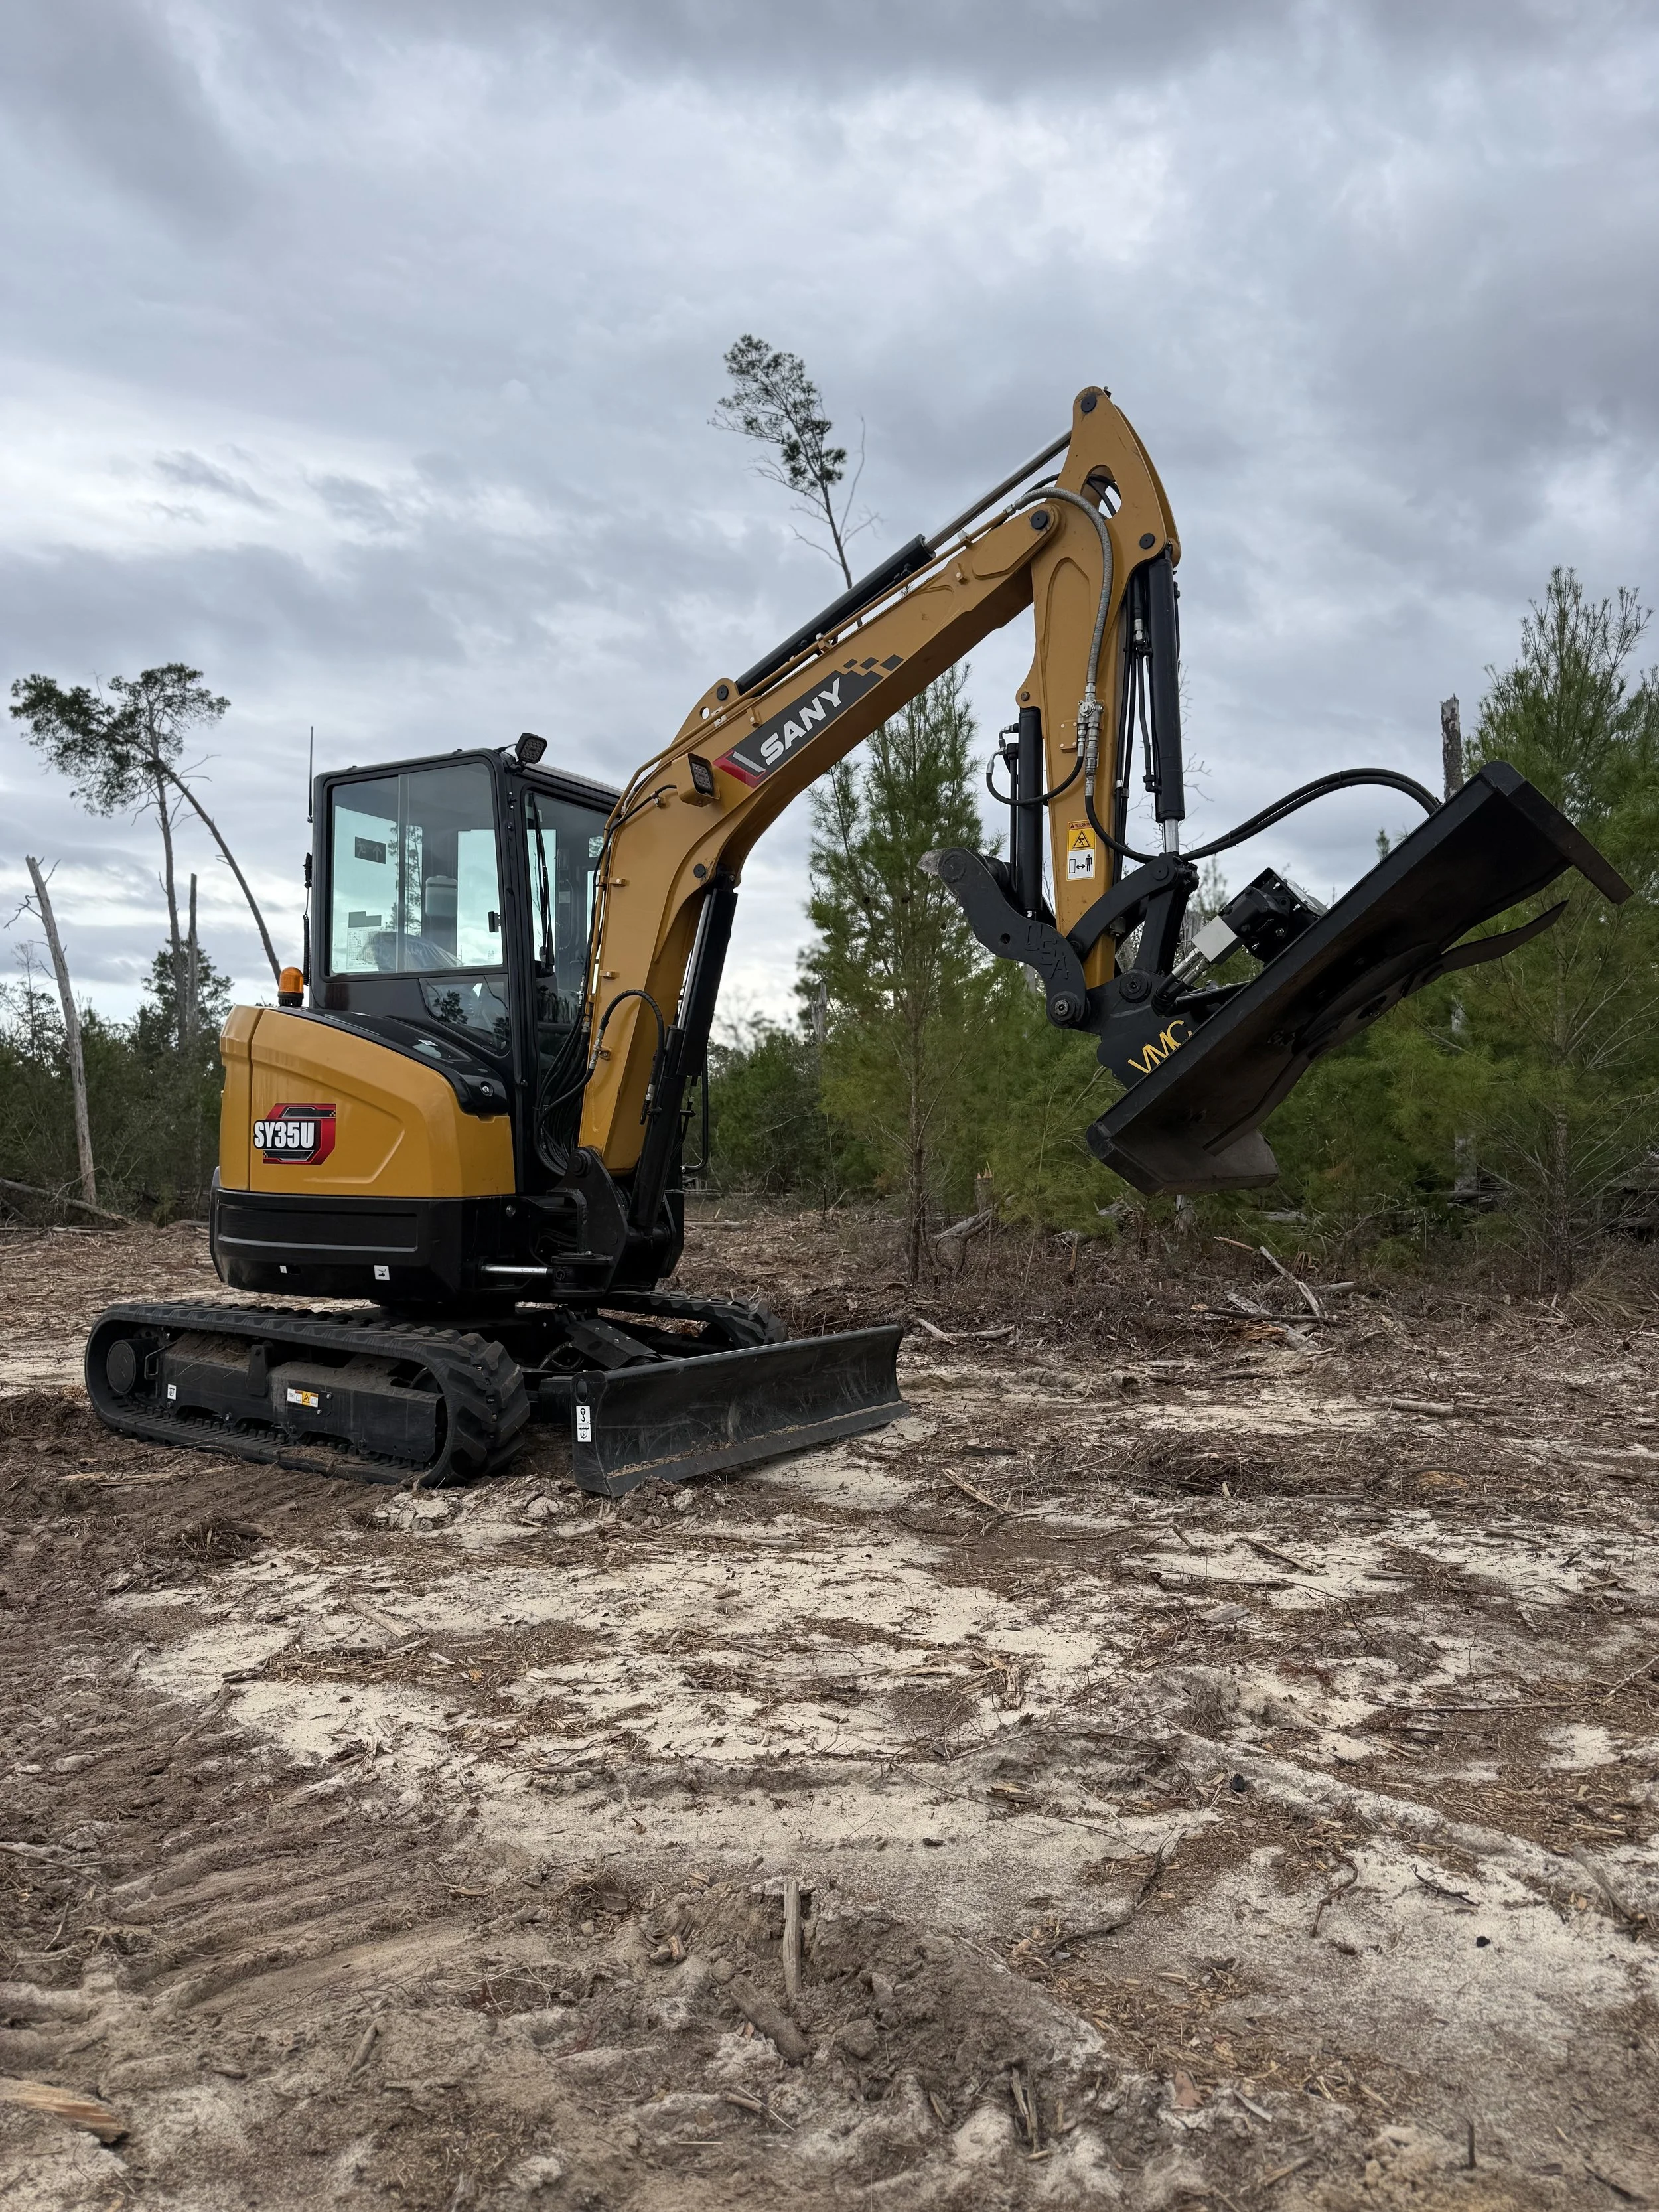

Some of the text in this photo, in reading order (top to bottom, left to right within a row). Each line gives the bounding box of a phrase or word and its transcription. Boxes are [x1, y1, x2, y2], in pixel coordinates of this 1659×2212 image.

[760, 676, 841, 766] SANY
[1024, 923, 1070, 980] USA
[1127, 1019, 1192, 1074] VMC
[254, 1121, 315, 1149] SY35U
